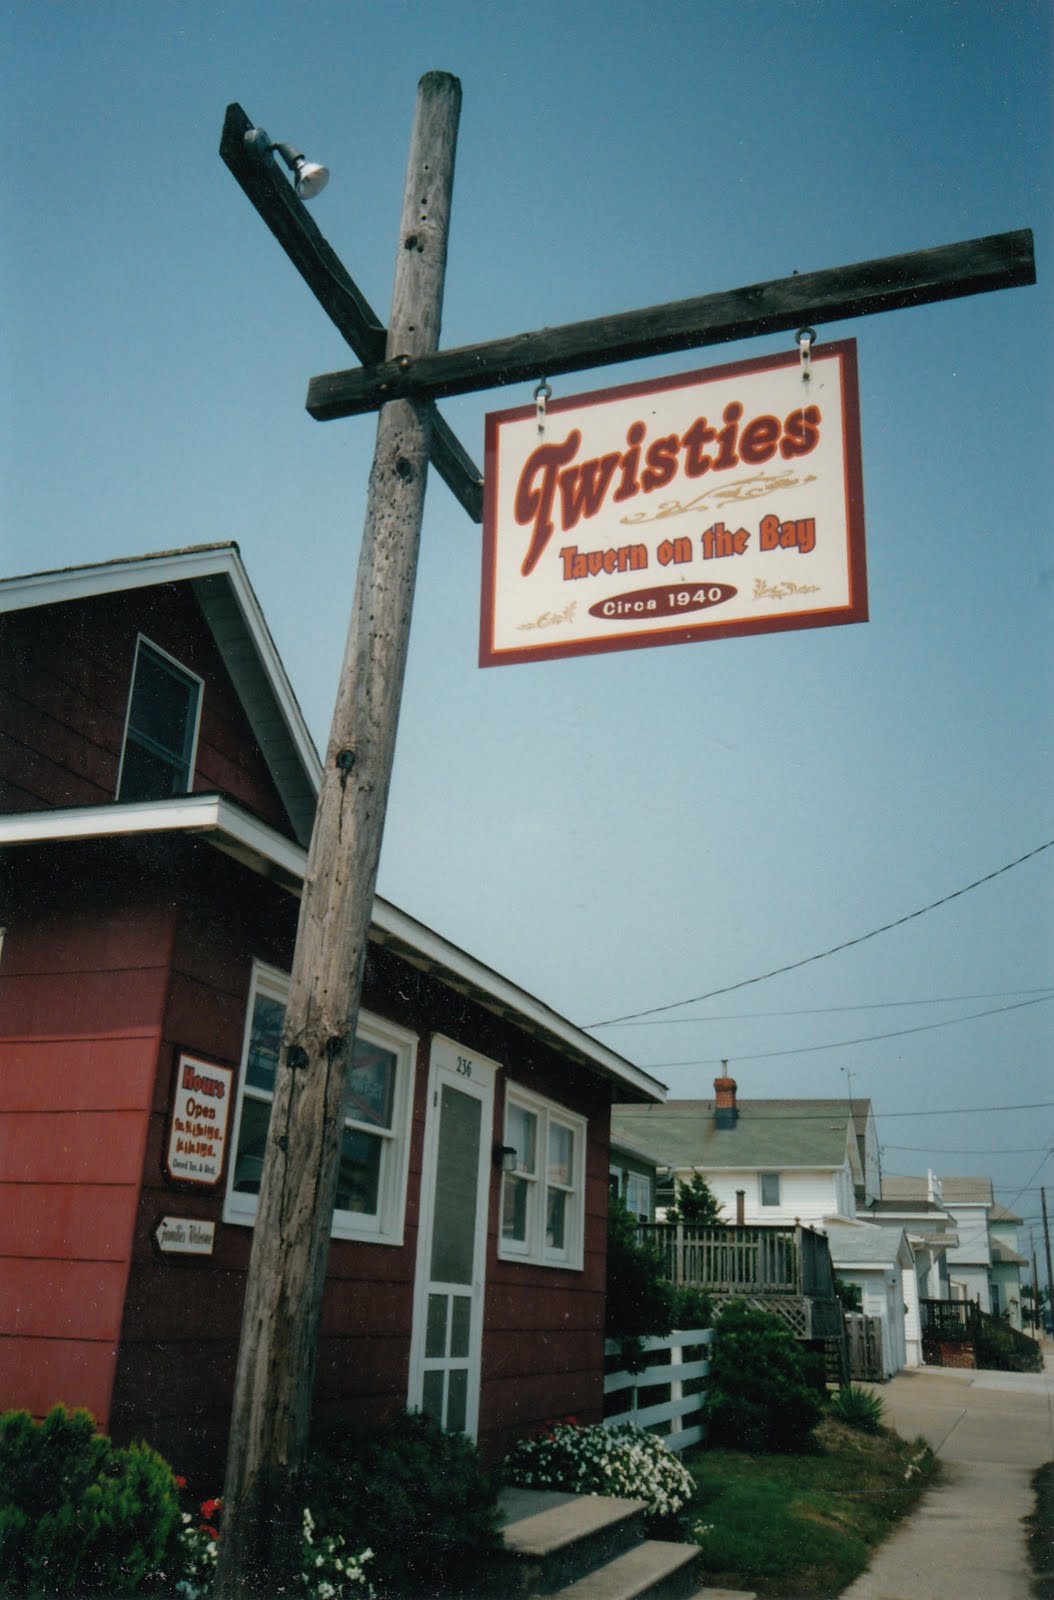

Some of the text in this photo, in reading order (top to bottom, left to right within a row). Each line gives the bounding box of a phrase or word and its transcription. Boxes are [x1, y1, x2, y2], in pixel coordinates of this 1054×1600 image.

[514, 400, 822, 577] Twisties
[559, 513, 816, 581] Tavern on the Bay
[602, 586, 722, 616] Circa 1940
[182, 1065, 225, 1099] Hours
[456, 1056, 472, 1077] 236
[186, 1097, 216, 1119] Open
